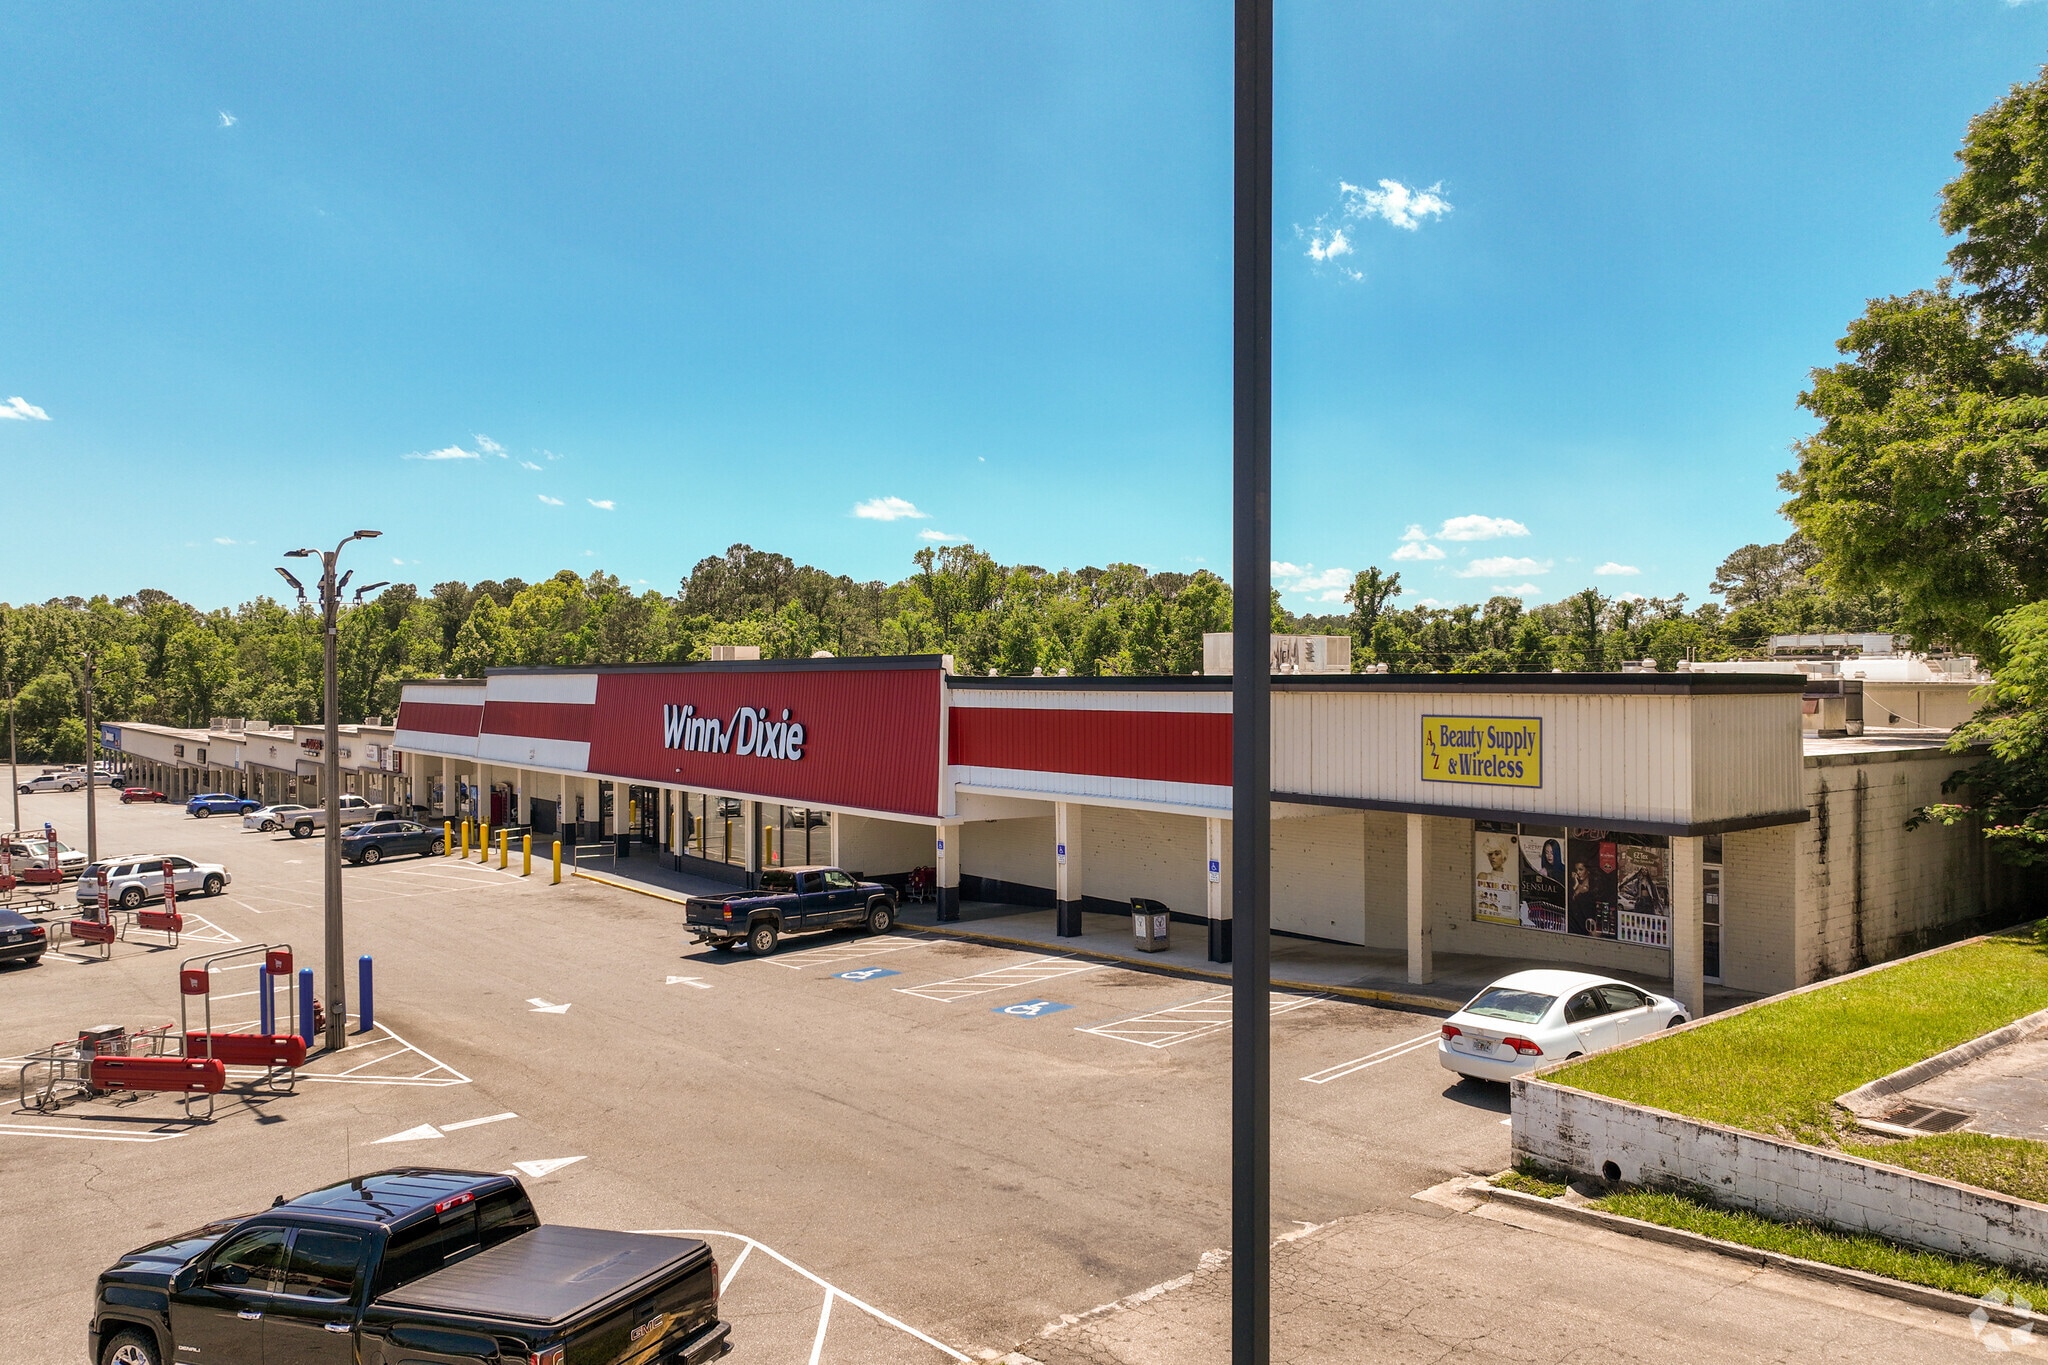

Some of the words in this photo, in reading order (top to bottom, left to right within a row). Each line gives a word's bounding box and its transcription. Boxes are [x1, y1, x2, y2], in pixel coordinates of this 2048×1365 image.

[664, 704, 720, 753] Winn
[736, 707, 804, 761] Dixie
[1440, 725, 1484, 755] Beauty
[1487, 725, 1536, 757] Supply
[1459, 752, 1524, 778] Wireless
[1573, 827, 1609, 839] OPEN
[1477, 880, 1500, 889] PIXIE
[1501, 883, 1517, 892] CUT
[630, 1313, 663, 1341] GMC
